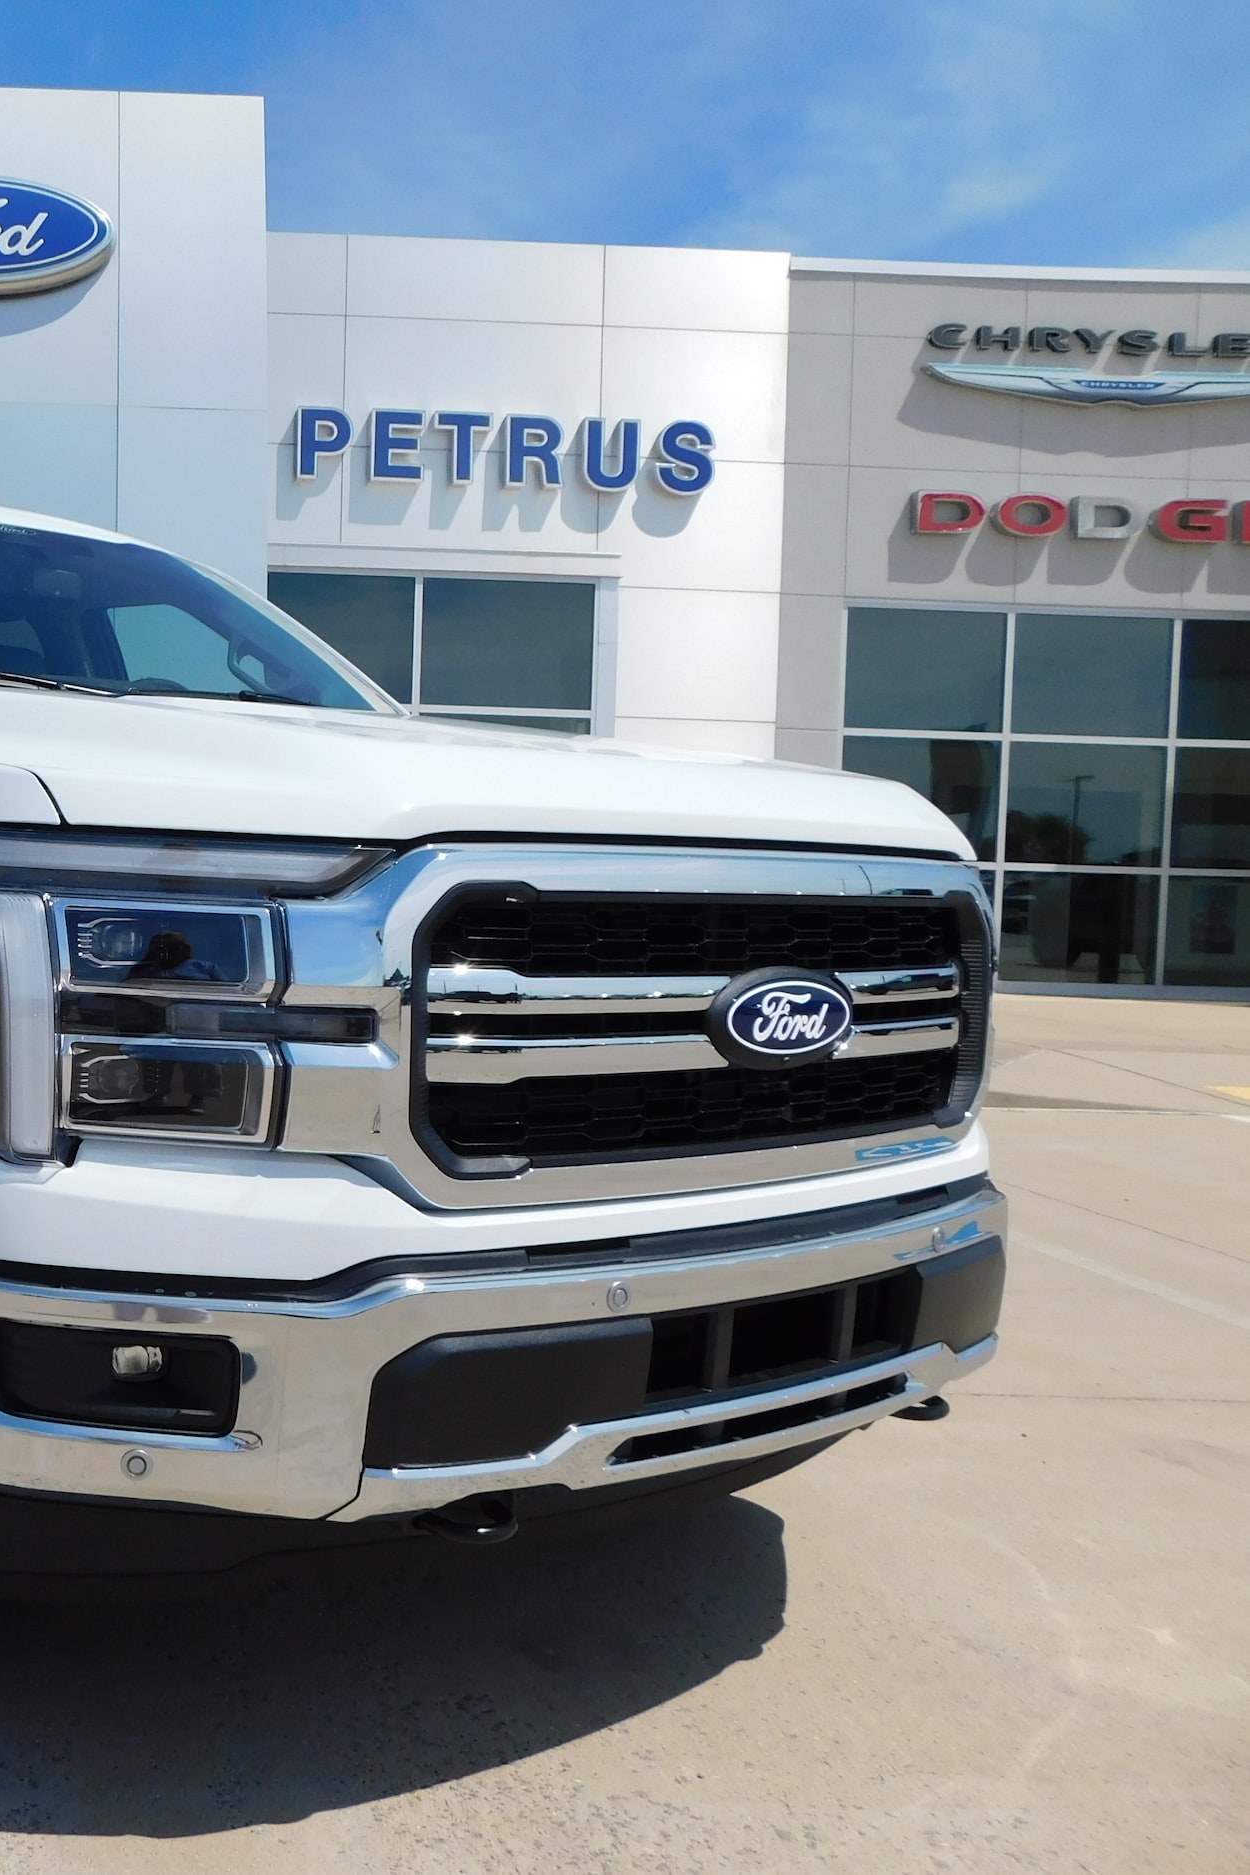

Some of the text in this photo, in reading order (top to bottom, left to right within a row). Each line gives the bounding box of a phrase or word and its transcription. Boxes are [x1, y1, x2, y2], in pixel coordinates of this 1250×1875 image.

[1080, 381, 1156, 389] CHRYSLER
[296, 405, 717, 496] PETRUS
[753, 991, 829, 1042] Ford
